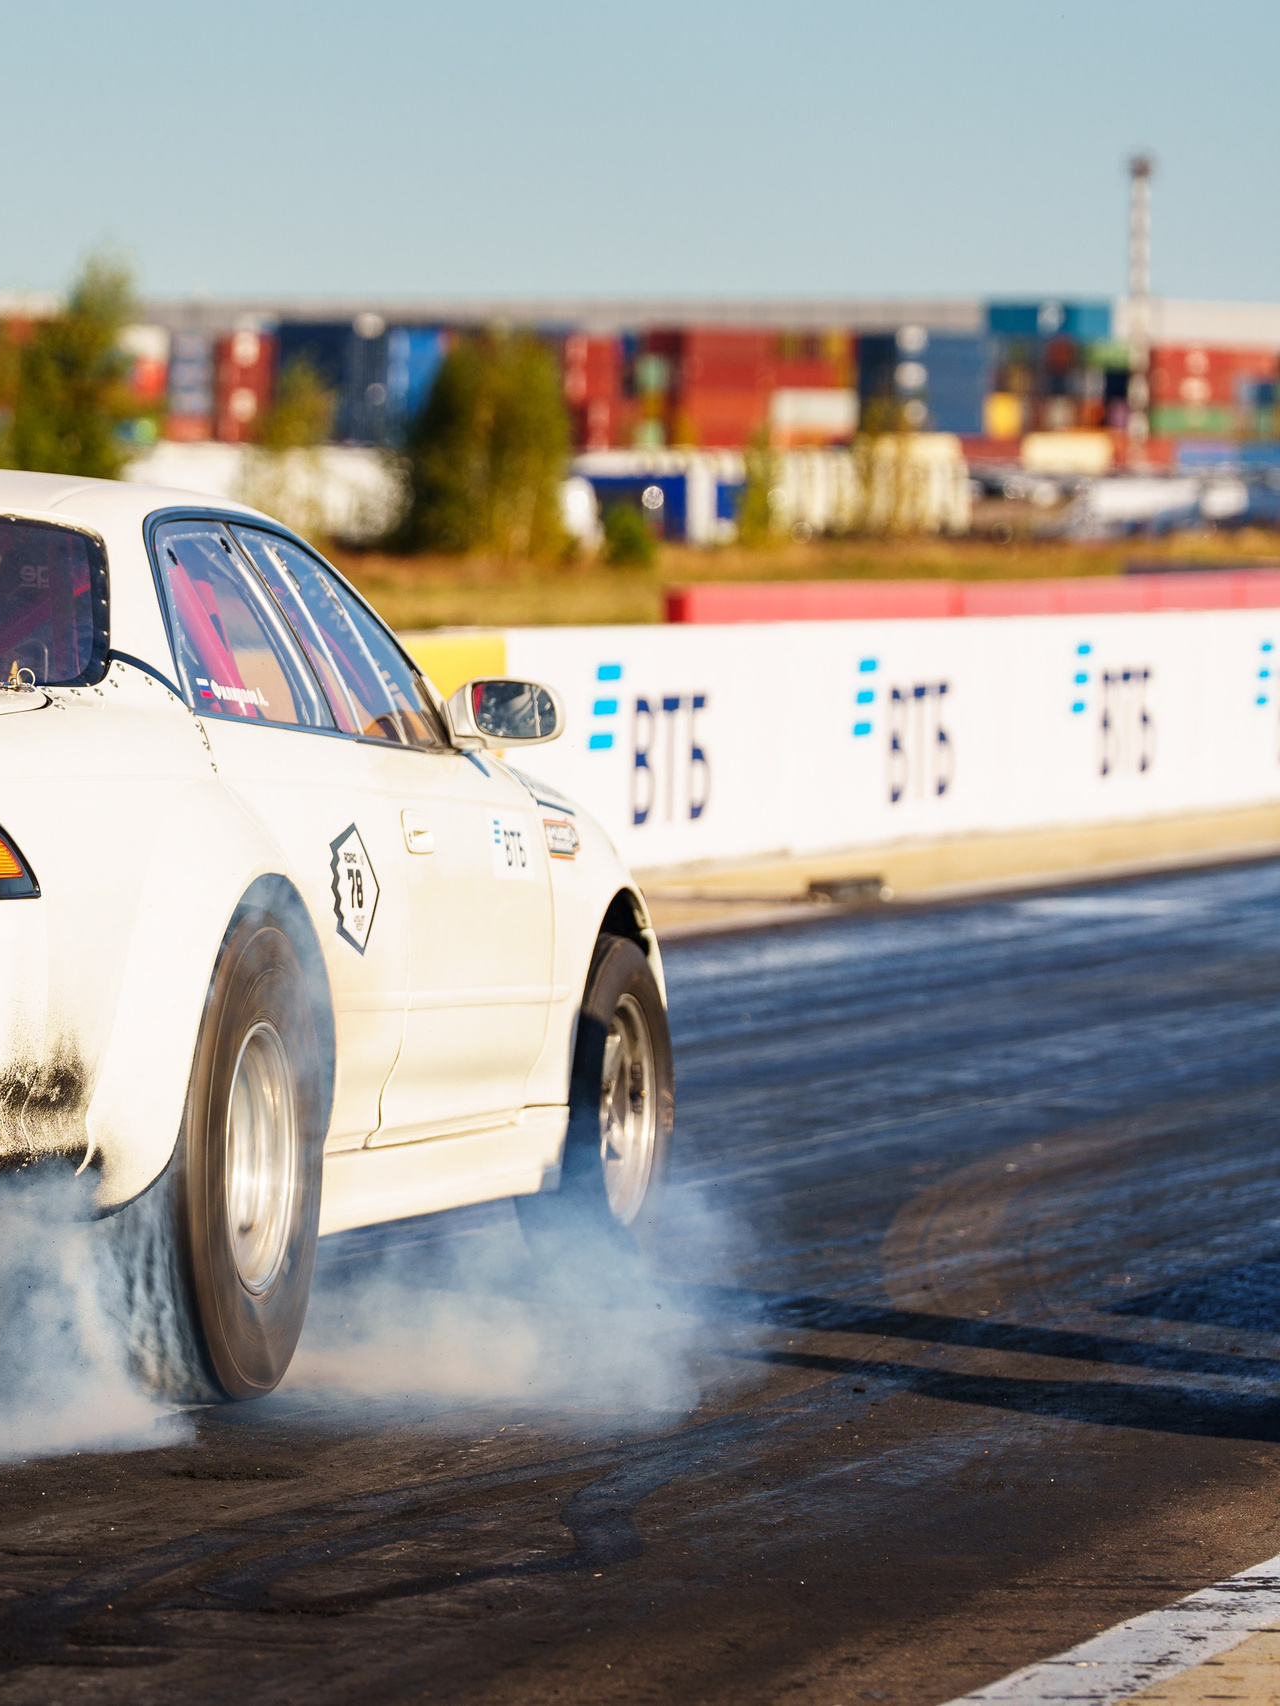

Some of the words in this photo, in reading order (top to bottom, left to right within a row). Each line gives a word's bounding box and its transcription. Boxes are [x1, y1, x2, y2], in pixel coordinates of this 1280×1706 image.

[631, 694, 712, 827] ВТБ
[886, 681, 956, 804] ВТБ
[347, 868, 363, 908] 78
[503, 829, 526, 868] ВТБ
